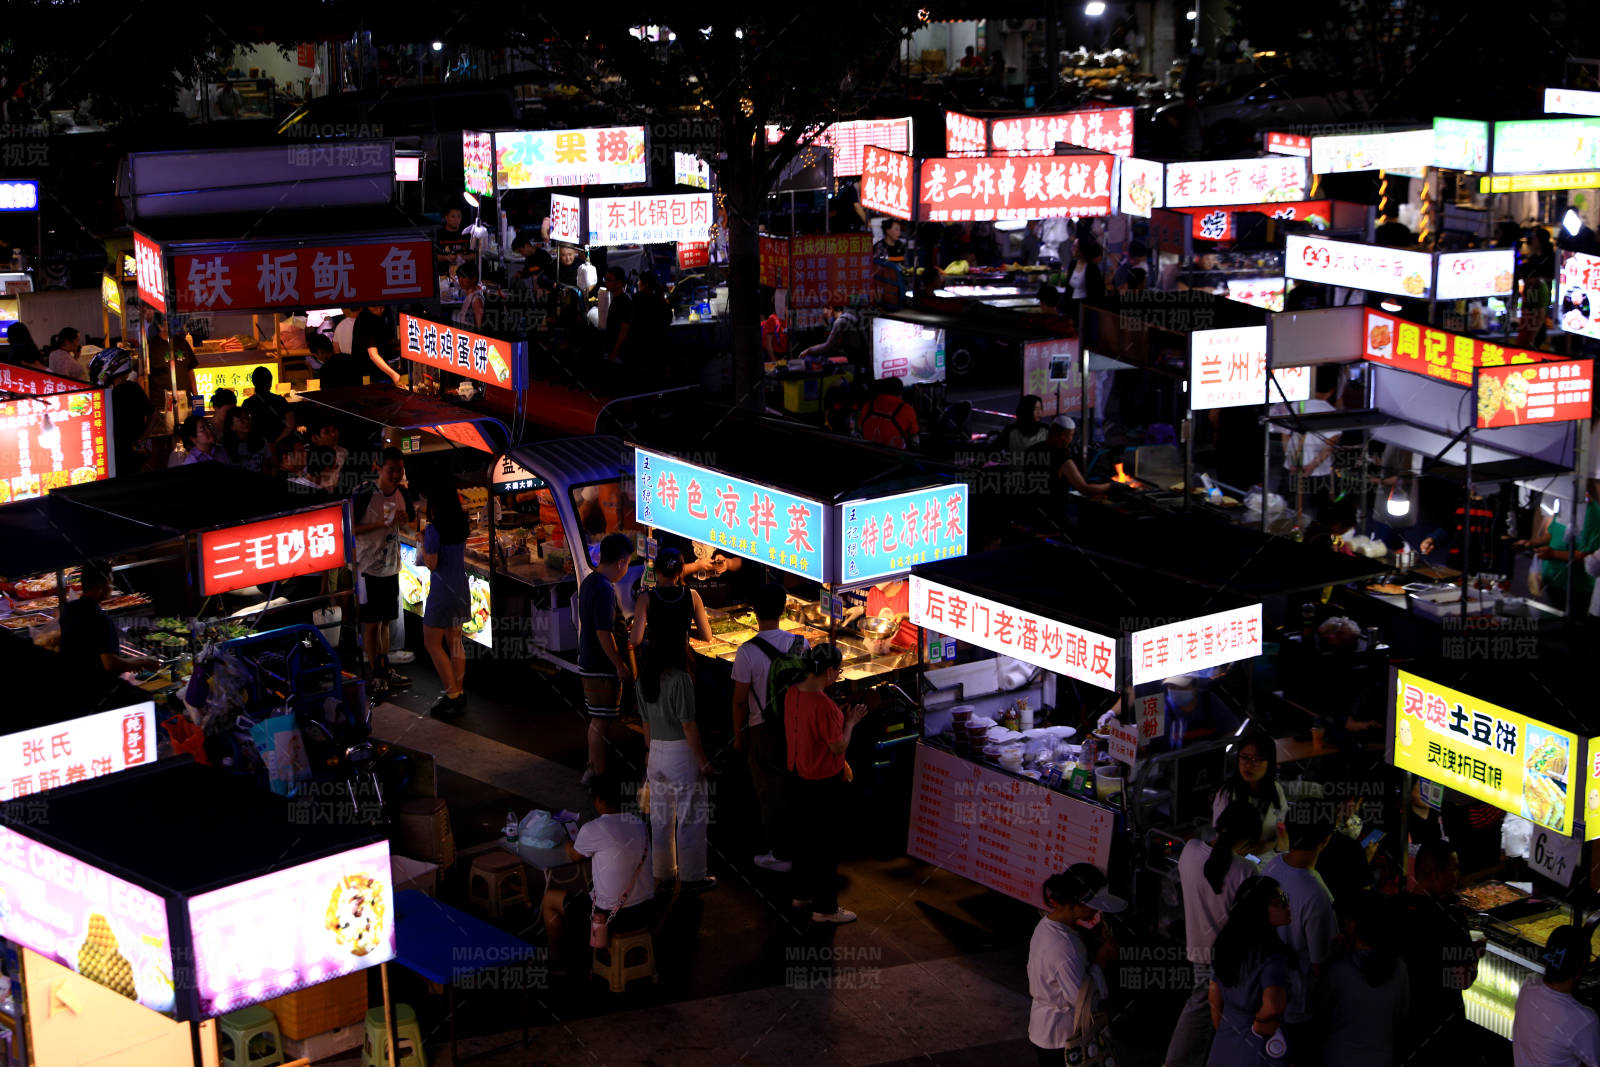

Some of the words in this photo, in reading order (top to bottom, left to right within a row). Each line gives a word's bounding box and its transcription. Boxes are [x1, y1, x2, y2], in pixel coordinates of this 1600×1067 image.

[511, 129, 629, 166] 水果捞
[865, 149, 909, 185] 老二炸串
[606, 196, 709, 229] 东北锅包肉
[187, 246, 422, 307] 铁板鱿鱼
[406, 319, 489, 375] 盐城鸡蛋饼
[657, 471, 815, 553] 特色凉拌菜
[860, 492, 964, 557] 特色凉拌菜
[212, 522, 336, 580] 三毛砂锅
[925, 588, 1113, 680] 后宰门老潘炒酿皮
[1140, 616, 1259, 671] 后宰门老潘炒酿皮
[1142, 697, 1159, 738] 凉粉
[1403, 684, 1518, 756] 灵魂土豆饼
[22, 731, 73, 768] 张氏
[1426, 740, 1503, 791] 灵魂折耳根
[0, 754, 114, 799] 面筋卷饼
[1534, 832, 1567, 877] 6元/个
